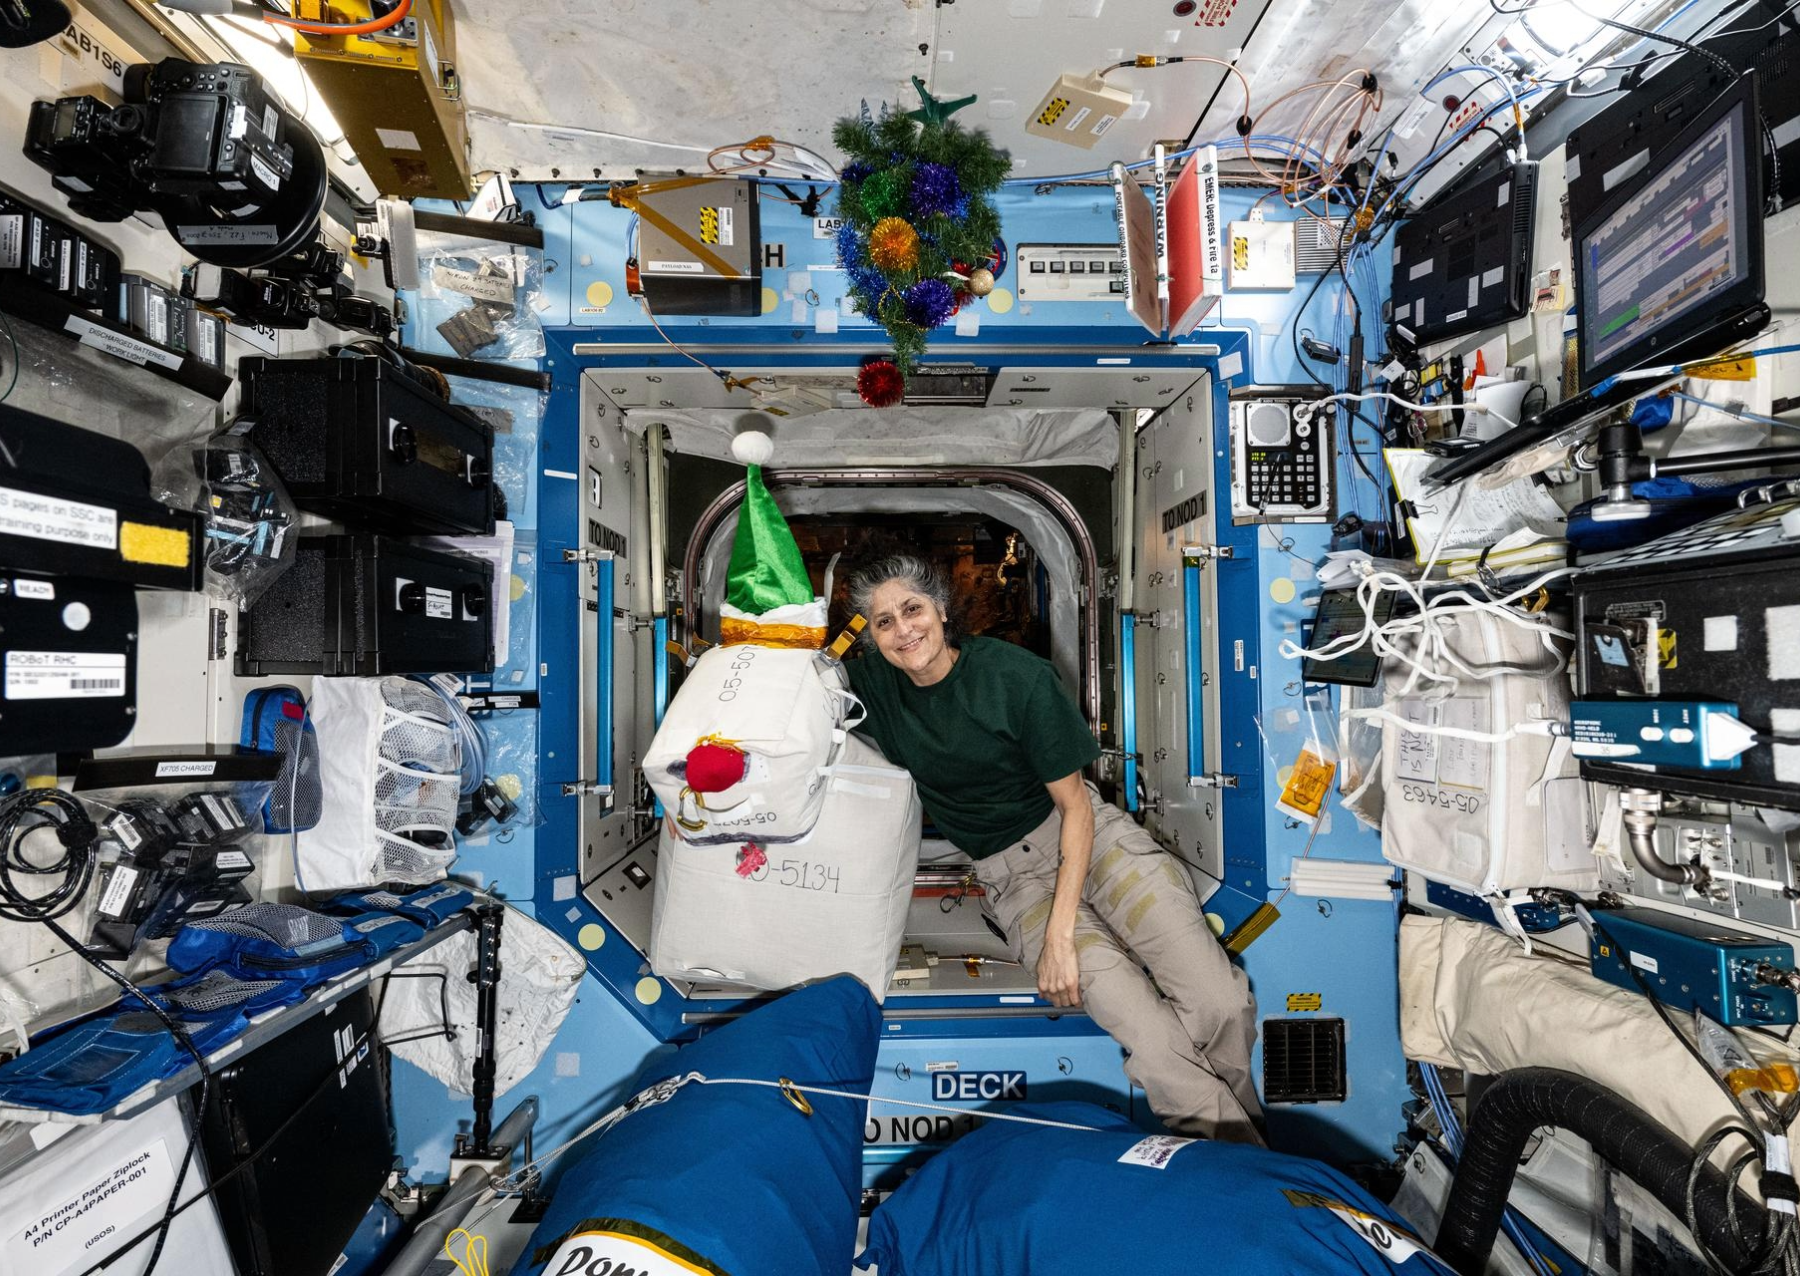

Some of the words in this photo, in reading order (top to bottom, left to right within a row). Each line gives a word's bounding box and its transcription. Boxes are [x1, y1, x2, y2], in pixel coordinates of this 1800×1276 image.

[1204, 177, 1214, 202] EMER:
[1116, 192, 1124, 225] PORTABLE
[1155, 172, 1166, 259] WARNING
[89, 327, 133, 350] DISCHARGED
[133, 344, 166, 362] BATTERIES
[105, 344, 128, 358] WORK
[127, 351, 146, 364] LIGHT
[13, 498, 48, 514] pages
[53, 506, 66, 516] on
[70, 506, 94, 521] SSC
[98, 515, 114, 525] are
[1163, 508, 1174, 534] TO
[1177, 498, 1197, 526] NOD
[45, 524, 90, 539] purpose
[92, 533, 114, 545] only
[589, 519, 601, 546] TO
[604, 528, 620, 554] NOD
[54, 655, 76, 664] RHC
[159, 764, 180, 773] XF705
[181, 763, 213, 773] CHARGED
[1412, 760, 1422, 772] IS
[936, 1074, 1024, 1099] DECK
[892, 1117, 954, 1142] NOD
[24, 1225, 39, 1240] A4
[41, 1200, 80, 1228] Printer
[82, 1177, 112, 1202] Paper
[112, 1151, 150, 1180] Ziplock
[32, 1230, 53, 1248] P/N
[55, 1167, 148, 1231] CP-A4PAPER-001
[84, 1225, 116, 1250] (USOS)
